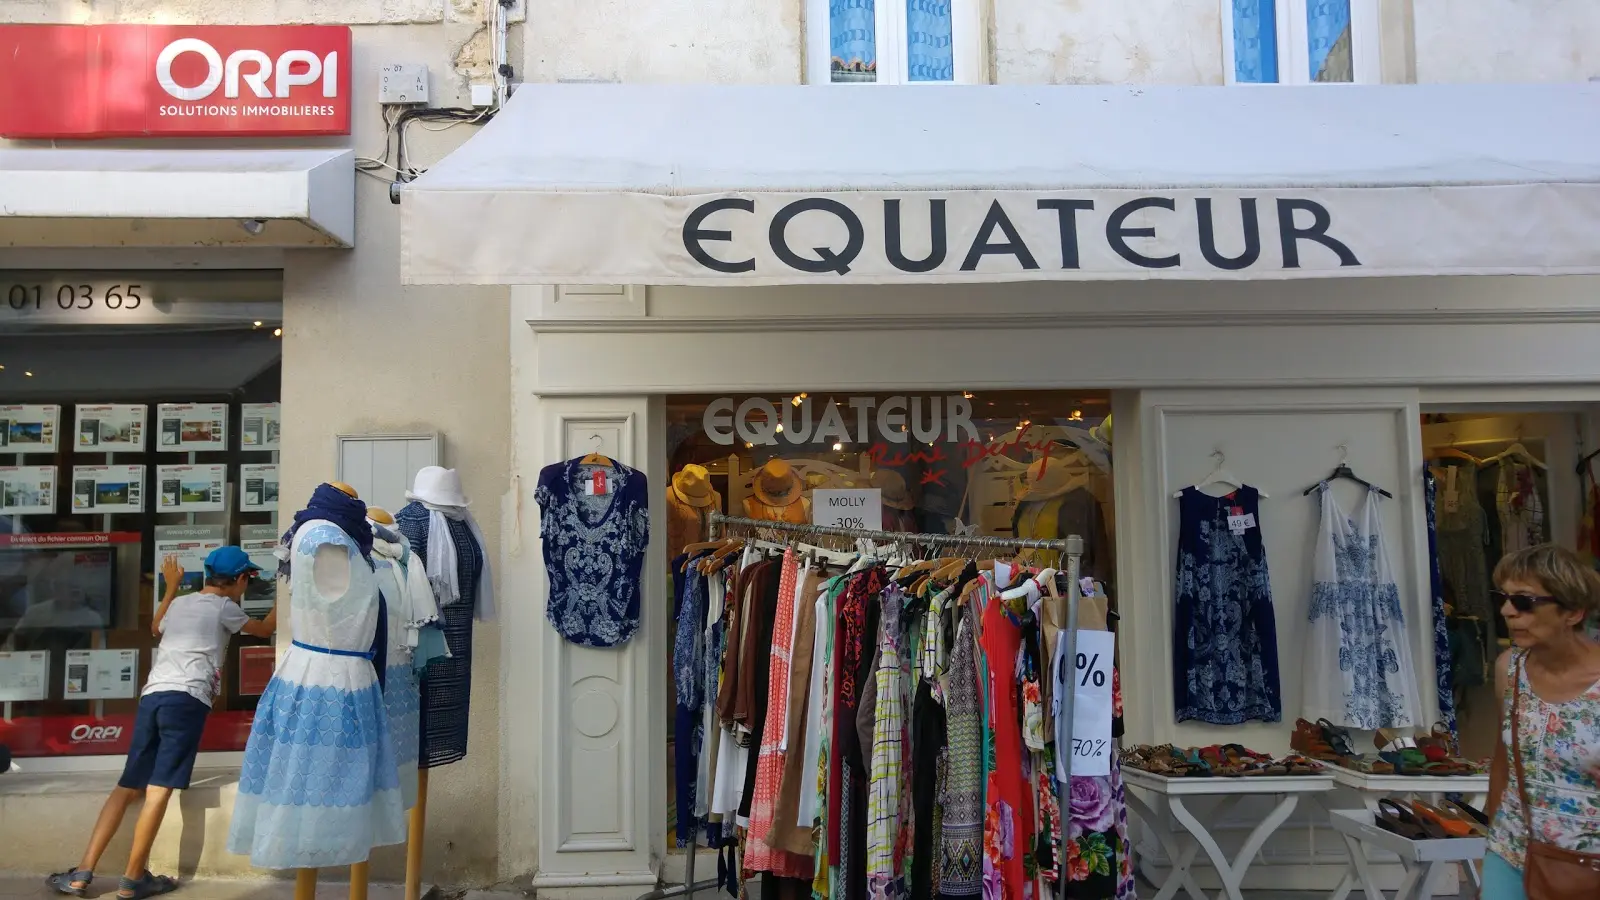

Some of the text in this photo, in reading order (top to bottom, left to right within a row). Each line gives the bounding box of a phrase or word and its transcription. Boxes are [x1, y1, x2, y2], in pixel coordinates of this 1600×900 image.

[156, 38, 338, 101] ORPI
[159, 105, 335, 117] SOLUTIONS IMMOBILIERES
[682, 197, 1362, 275] EQUATEUR
[8, 284, 142, 310] 01 03 65
[702, 395, 980, 446] EQUATEUR
[828, 497, 866, 507] MOLLY
[830, 517, 865, 529] -30%
[70, 724, 123, 740] ORPI
[1072, 738, 1107, 758] 70%
